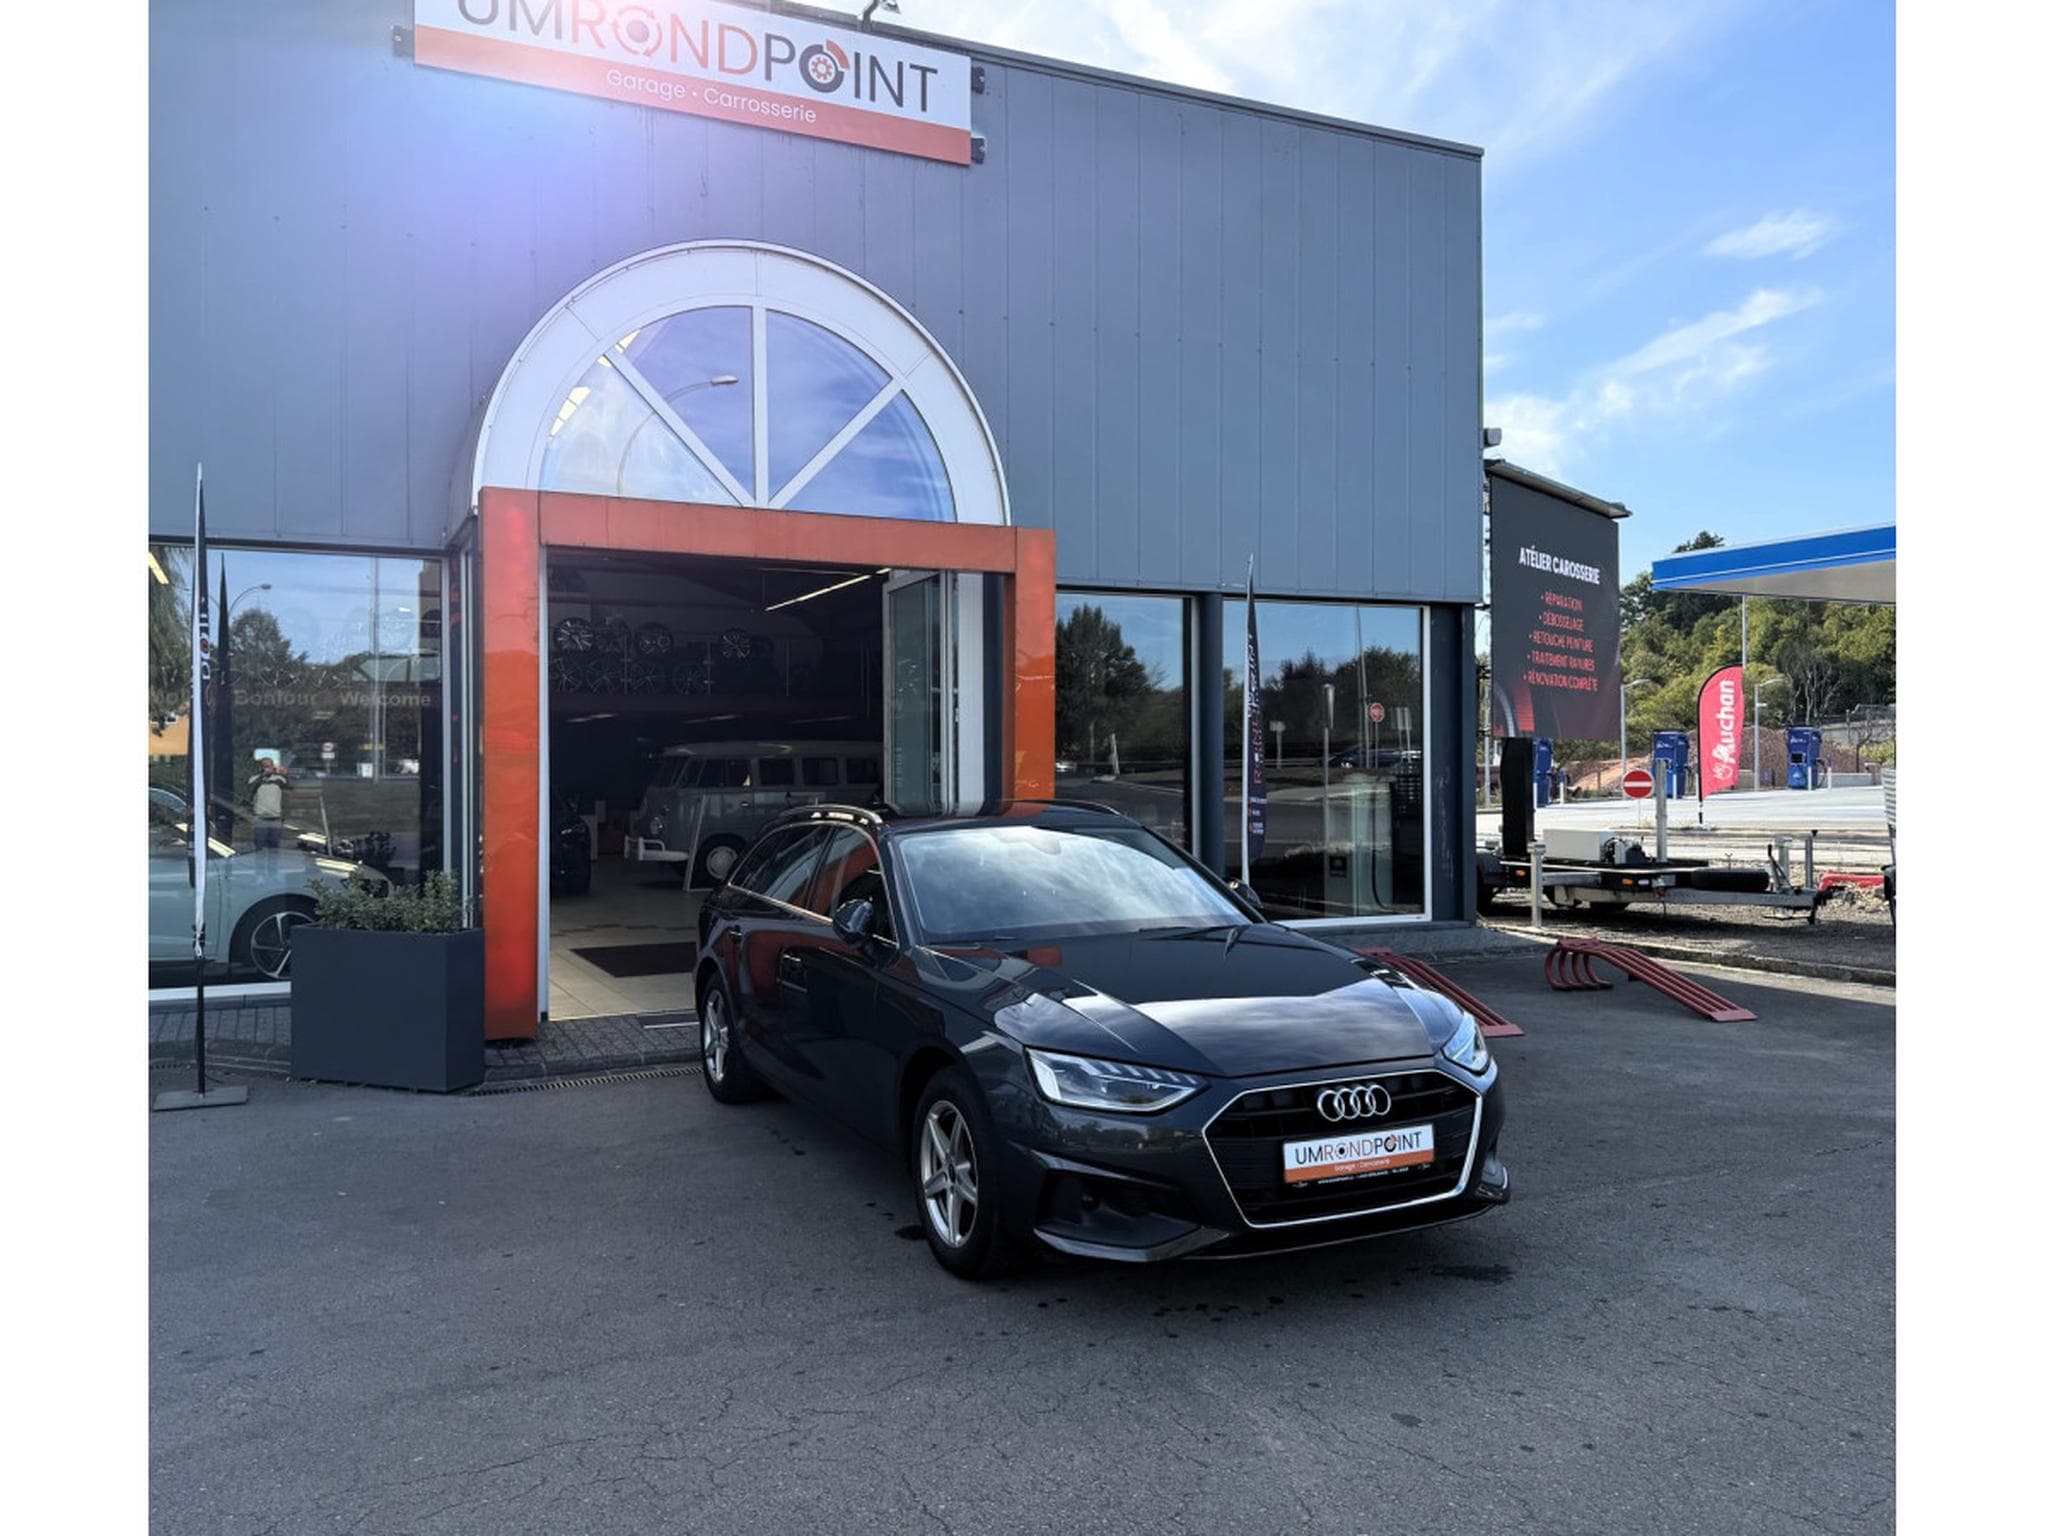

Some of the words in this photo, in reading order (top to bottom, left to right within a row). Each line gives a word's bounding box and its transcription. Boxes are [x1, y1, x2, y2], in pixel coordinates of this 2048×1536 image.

[606, 69, 686, 100] Garage
[704, 87, 817, 123] Carrosserie
[1552, 556, 1600, 585] CAROSSERIE
[1712, 680, 1736, 764] Auchan
